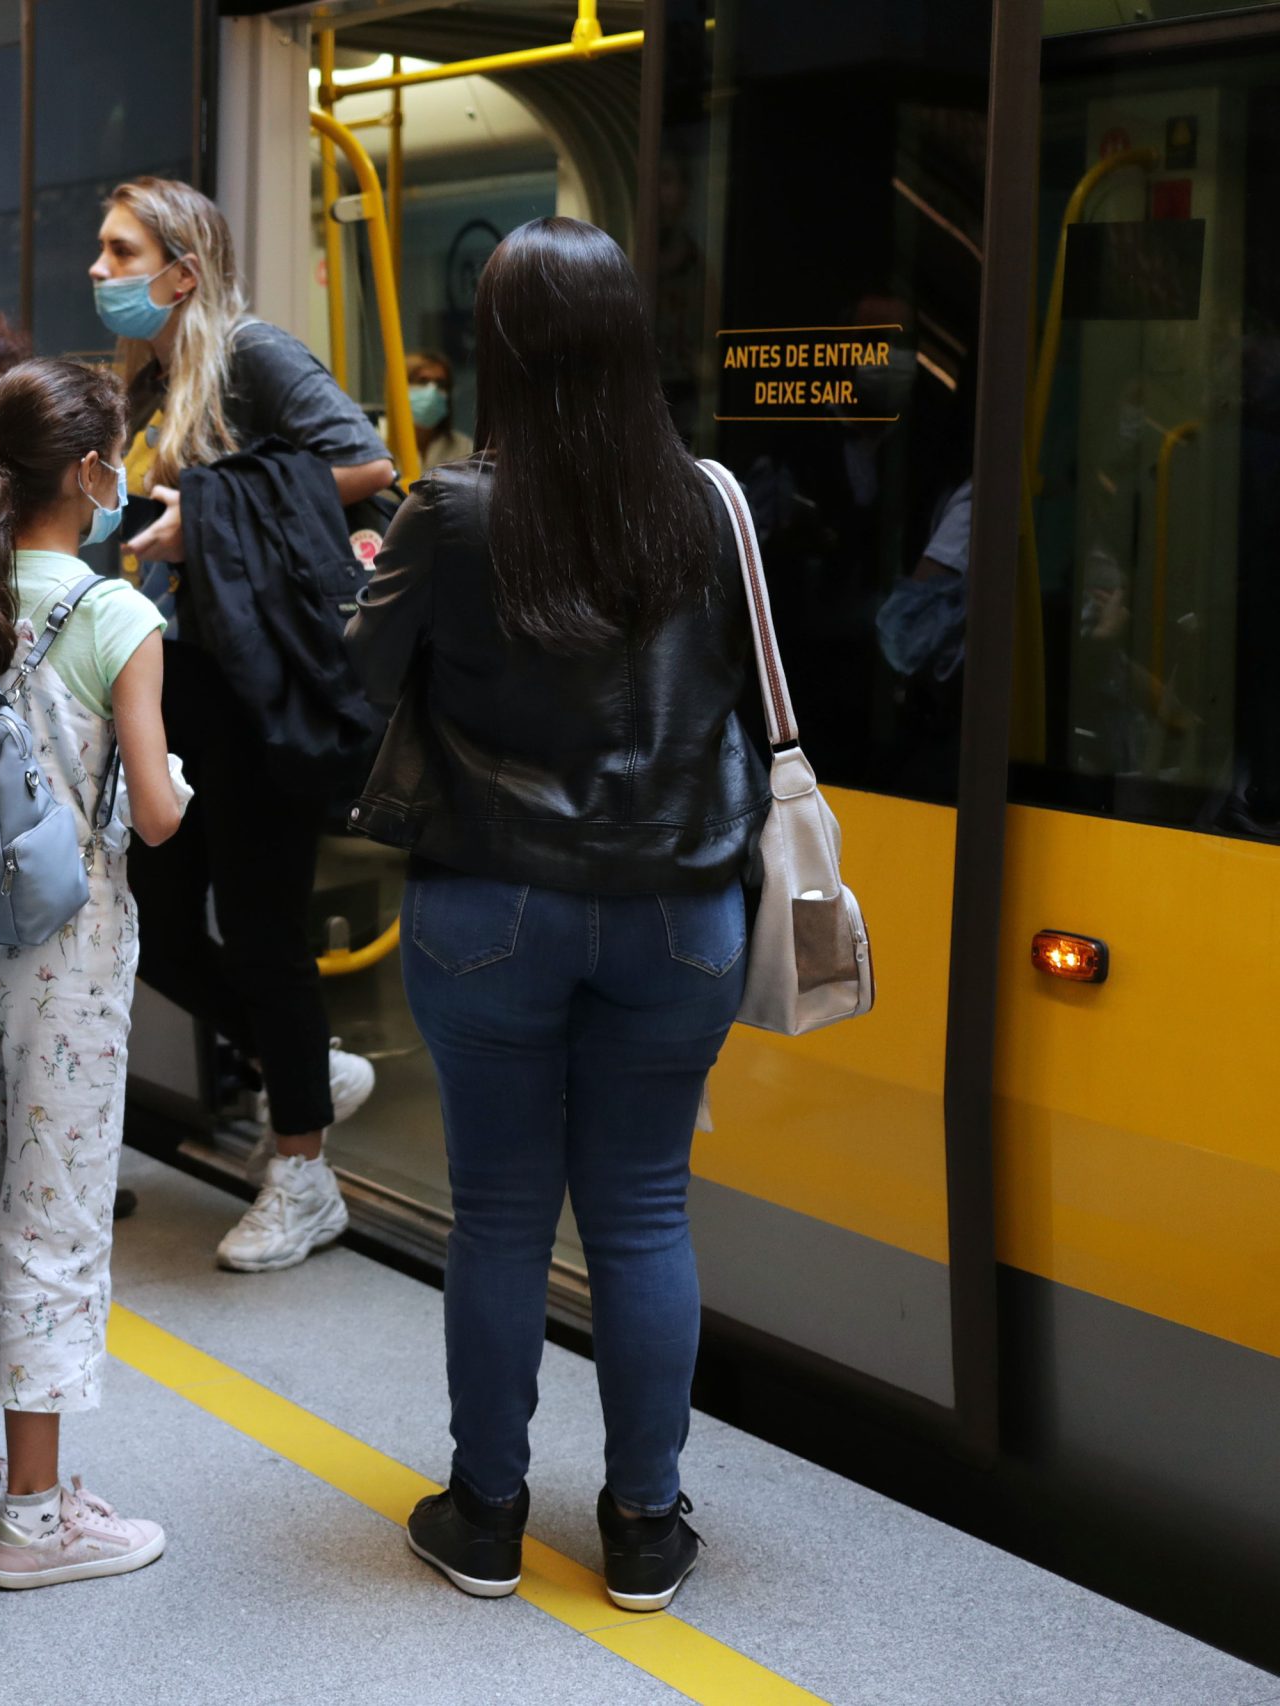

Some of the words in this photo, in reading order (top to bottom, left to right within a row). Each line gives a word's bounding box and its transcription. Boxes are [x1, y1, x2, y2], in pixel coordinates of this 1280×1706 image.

[724, 345, 781, 368] ANTES
[786, 344, 809, 367] DE
[814, 342, 890, 367] ENTRAR
[755, 381, 806, 405] DEIXE
[810, 381, 858, 404] SAIR.
